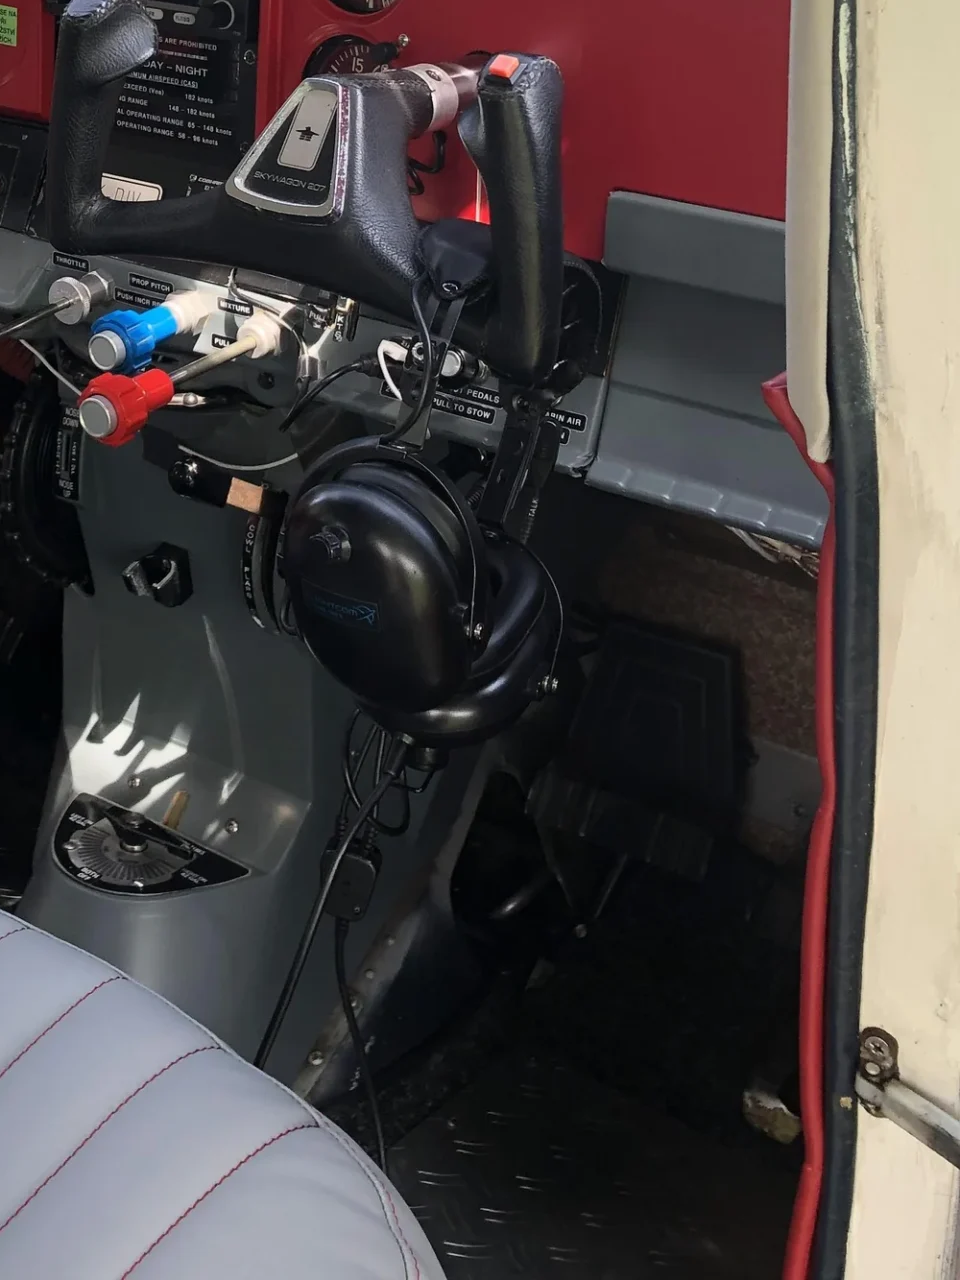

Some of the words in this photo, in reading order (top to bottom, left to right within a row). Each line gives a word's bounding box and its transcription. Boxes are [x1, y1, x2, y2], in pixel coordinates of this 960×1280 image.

[164, 37, 178, 45] ARE
[179, 39, 218, 51] PROHIBITED
[143, 60, 164, 70] DAY
[175, 64, 208, 78] NIGHT
[352, 56, 364, 72] 15
[123, 83, 147, 93] EXCEED
[149, 74, 179, 86] AIRSPEED
[180, 79, 198, 90] (CAS)
[197, 95, 214, 104] knots
[127, 96, 149, 106] RANGE
[198, 110, 215, 119] knots
[126, 109, 161, 122] OPERATING
[162, 116, 184, 127] RANGE
[215, 127, 232, 136] knots
[116, 120, 152, 133] OPERATING
[153, 126, 175, 137] RANGE
[202, 137, 219, 146] knots
[253, 170, 306, 189] SKYWAGON
[308, 182, 327, 192] 207
[56, 255, 87, 269] THROTTLE
[131, 277, 149, 287] PROP
[150, 281, 171, 292] PITCH
[117, 291, 134, 301] PUSH
[134, 296, 150, 306] INCR
[220, 300, 251, 313] MIXTURE
[214, 338, 231, 347] PULL
[466, 388, 500, 404] PEDALS
[65, 407, 80, 417] NOSE
[432, 397, 451, 410] PULL
[453, 403, 465, 412] TO
[466, 405, 491, 419] STOW
[62, 417, 79, 428] DOWN
[566, 416, 582, 427] AIR
[59, 479, 74, 490] NOSE
[528, 497, 539, 517] TALK
[245, 524, 256, 553] COWL
